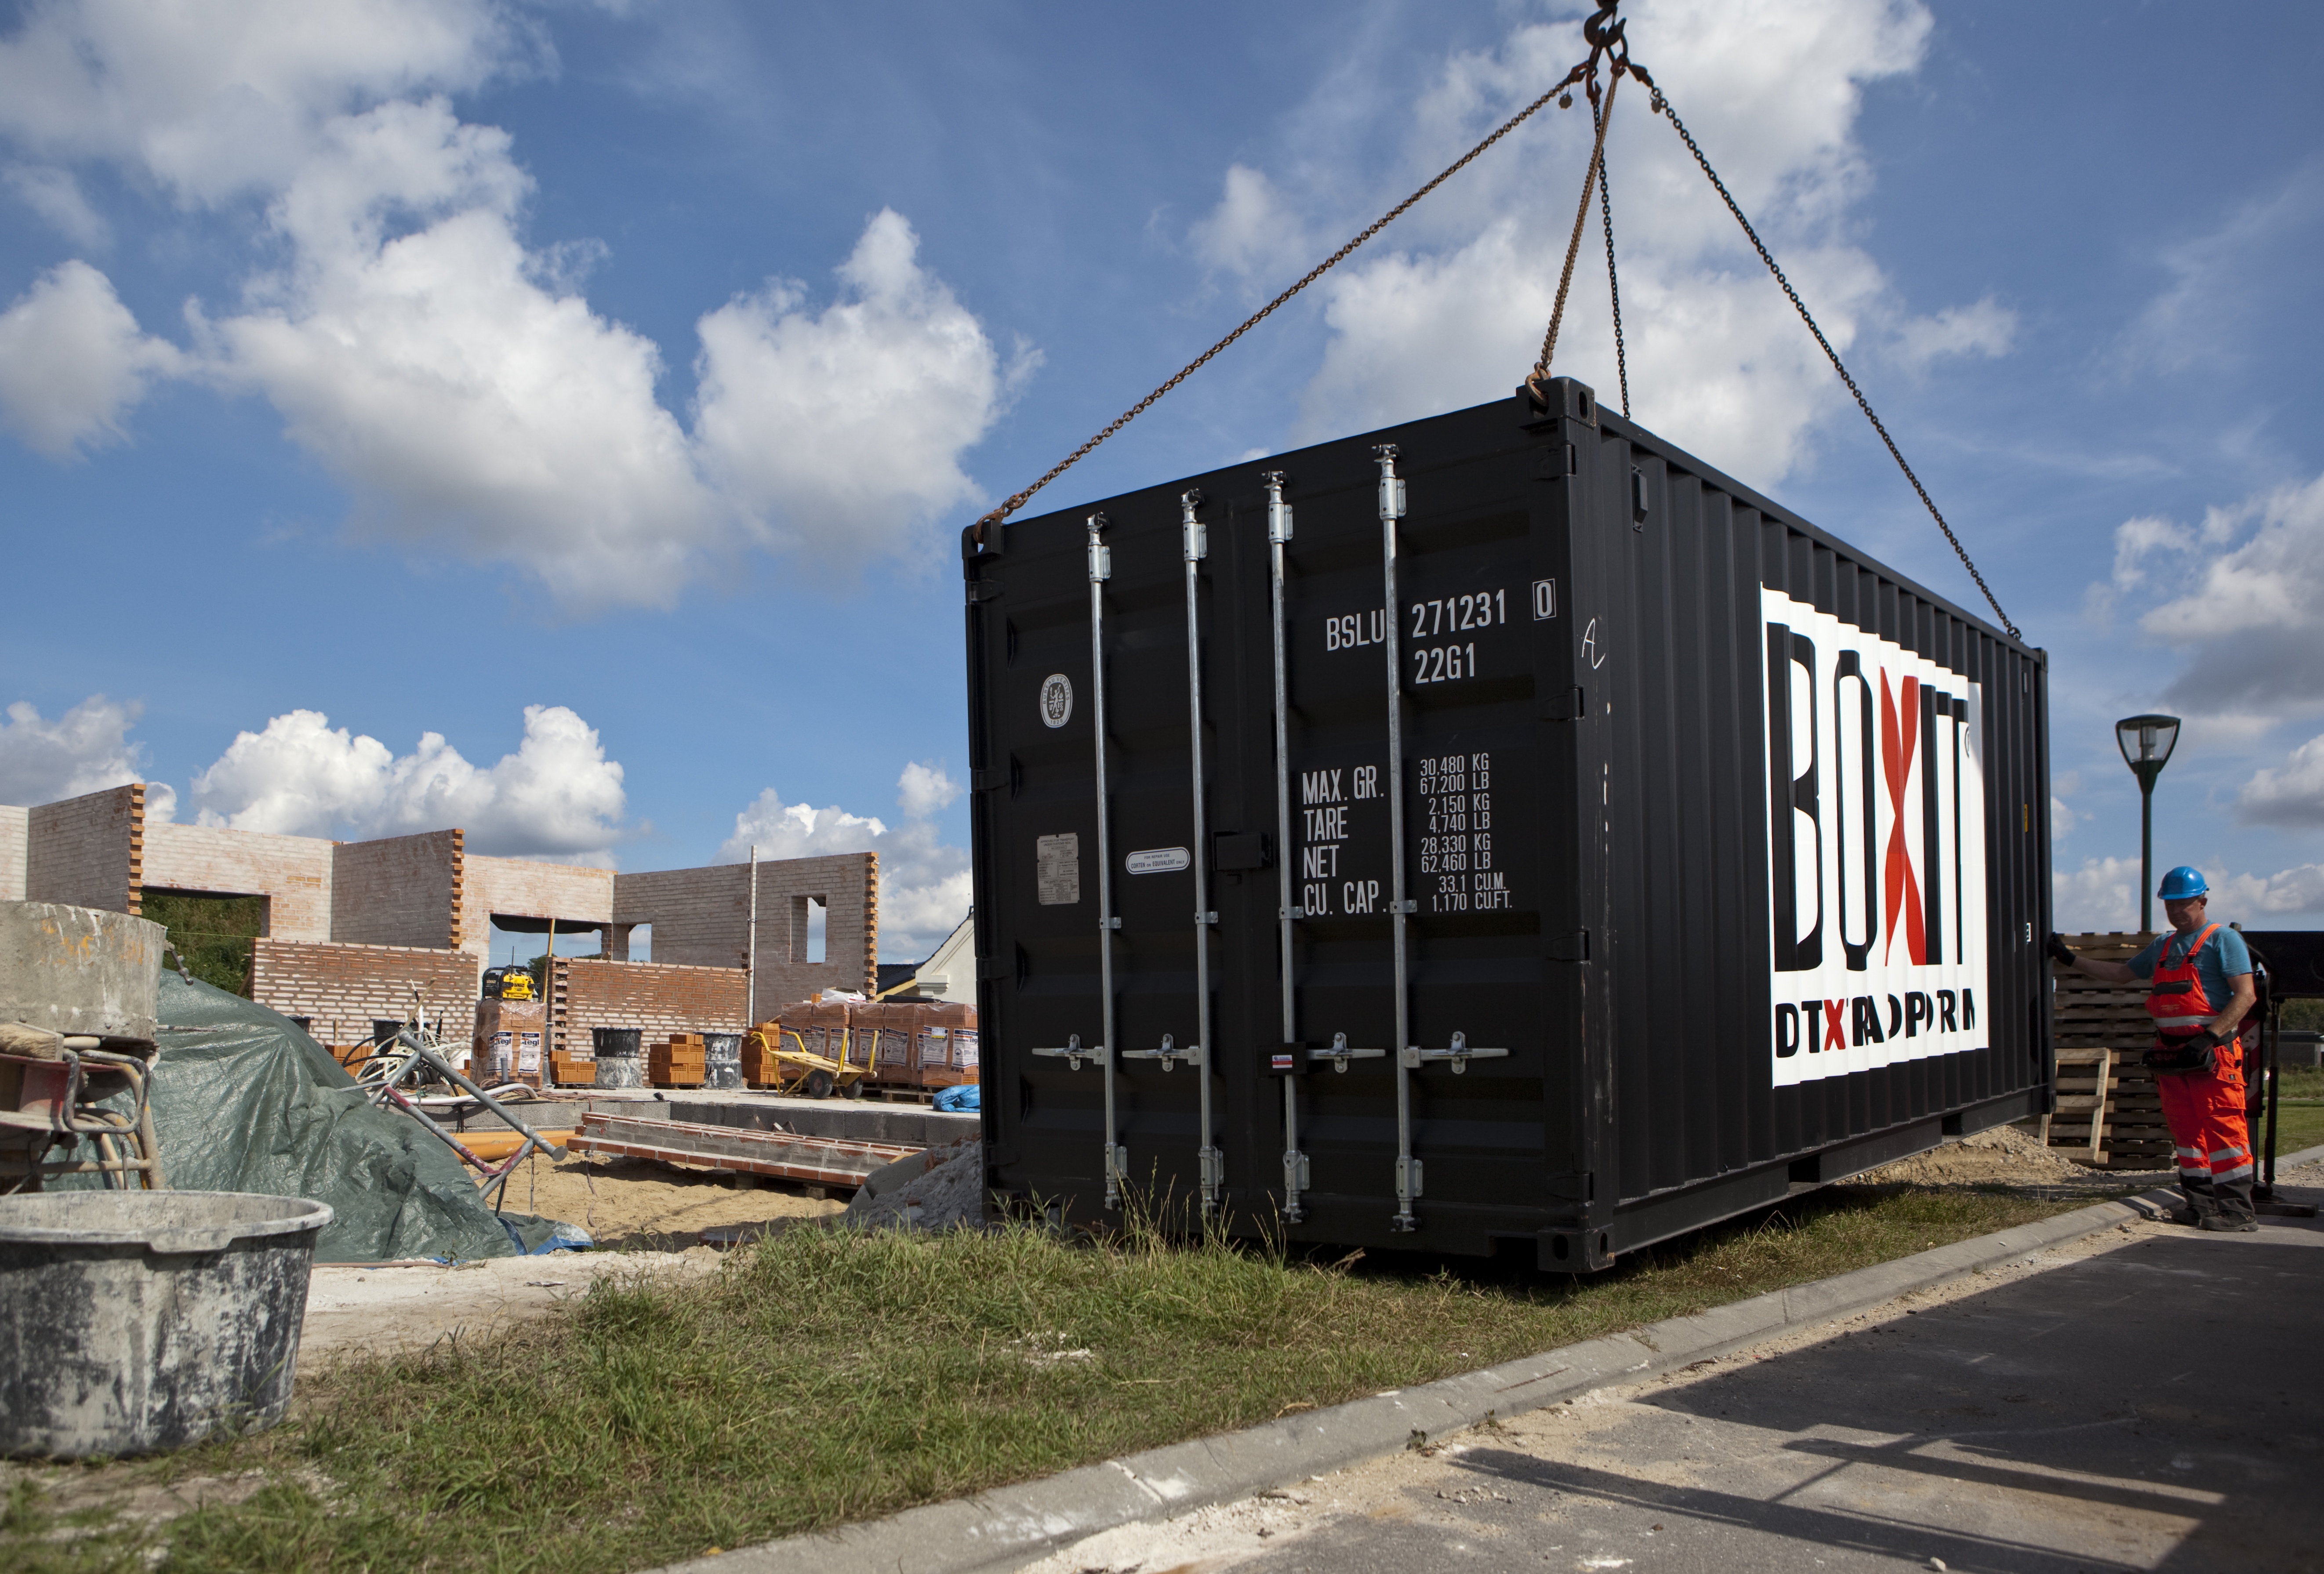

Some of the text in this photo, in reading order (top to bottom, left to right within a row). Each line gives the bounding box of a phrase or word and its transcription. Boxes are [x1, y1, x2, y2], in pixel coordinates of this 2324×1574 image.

[1326, 609, 1385, 651] BSLU
[1412, 589, 1505, 638] 271231
[1415, 642, 1475, 684] 22G1
[1043, 677, 1070, 704] BUREAU VERITAS
[1420, 753, 1489, 776] 30,480 KG
[1302, 765, 1384, 805] MAX. GR.
[1420, 772, 1489, 794] 67,200 LB
[1428, 793, 1490, 816] 2,150 KG
[1304, 806, 1348, 842] TARE
[1429, 812, 1490, 834] 4,740 LB
[1421, 833, 1491, 855] 28,330 KG
[1304, 844, 1340, 879] NET
[1421, 852, 1491, 873] 62,460 LB
[1438, 875, 1466, 893] 33.1
[1304, 880, 1387, 916] CU. CAP.
[1432, 893, 1467, 913] 1,170
